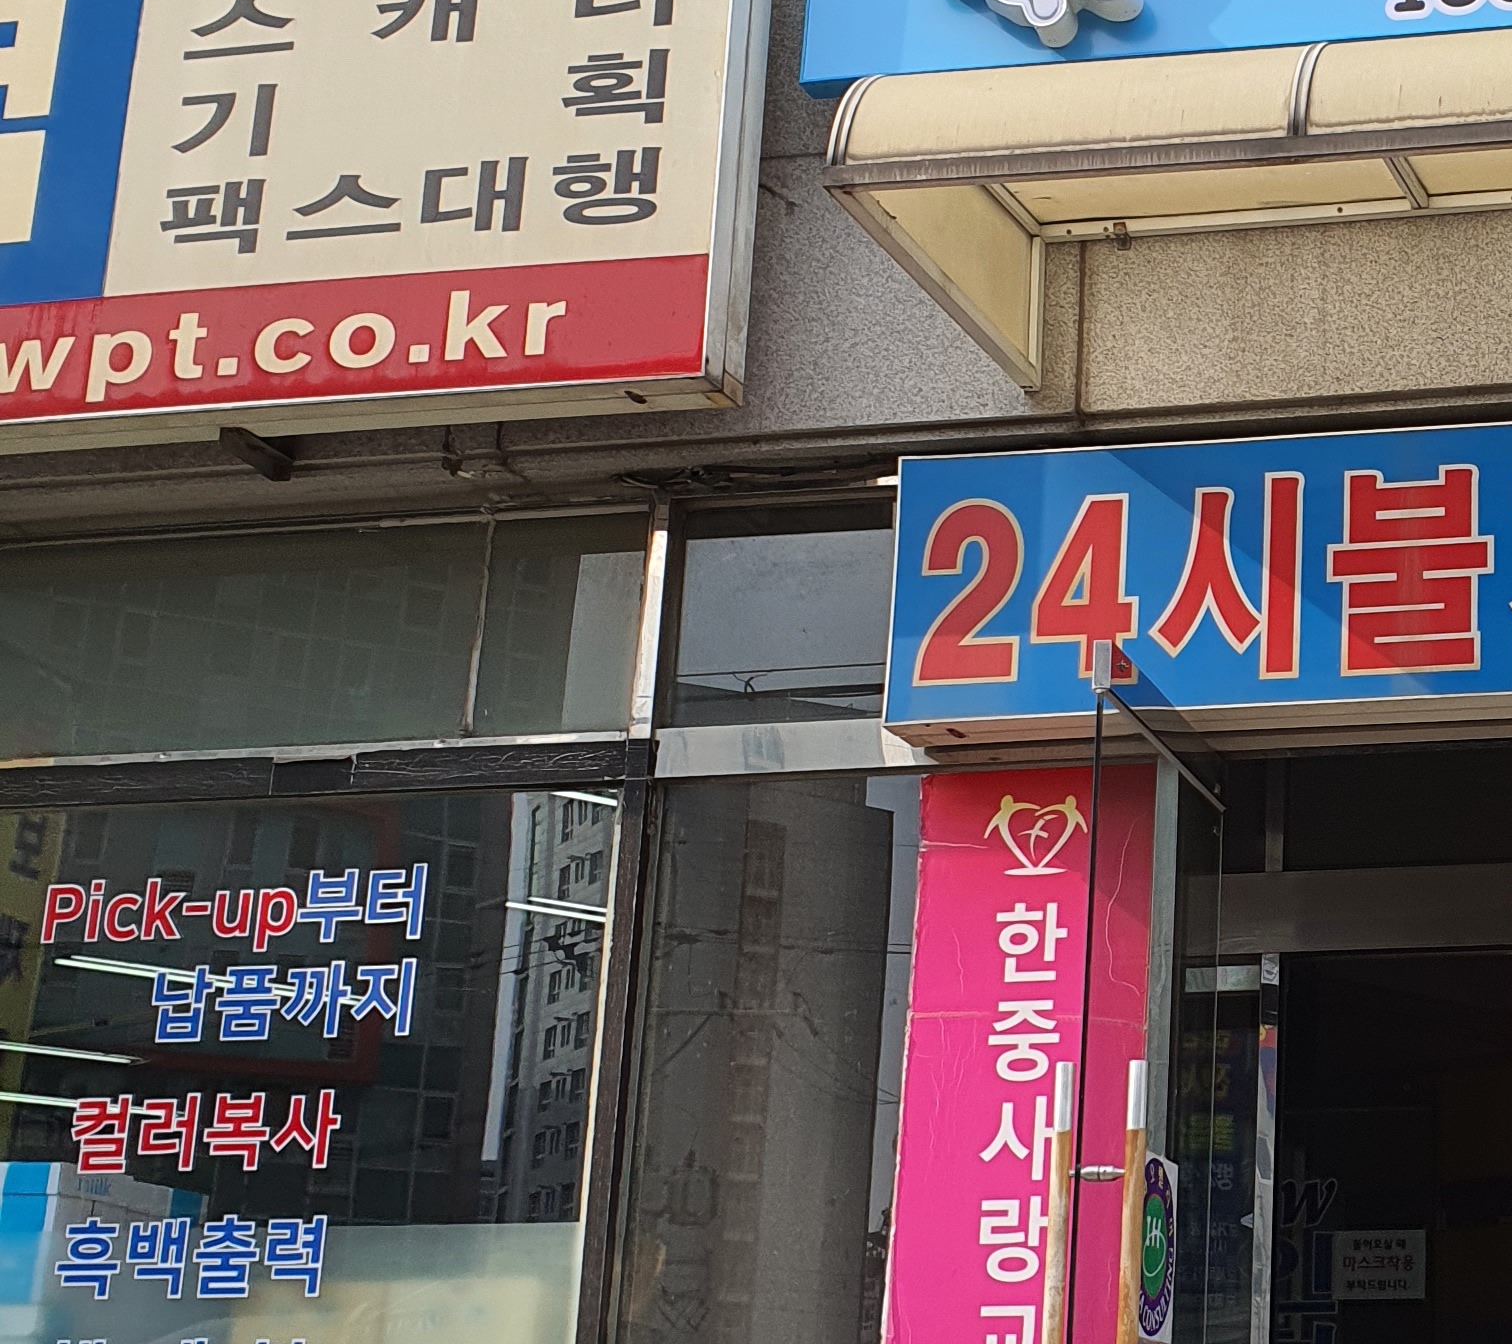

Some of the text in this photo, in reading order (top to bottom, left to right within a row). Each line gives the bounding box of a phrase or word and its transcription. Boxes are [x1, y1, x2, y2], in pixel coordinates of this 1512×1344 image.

[160, 146, 662, 255] 팩스대행
[151, 958, 418, 1044] 납품까지
[71, 1089, 342, 1174] 컬러복사
[55, 1214, 328, 1300] 흑백출력
[1342, 1254, 1415, 1271] 마스크착용
